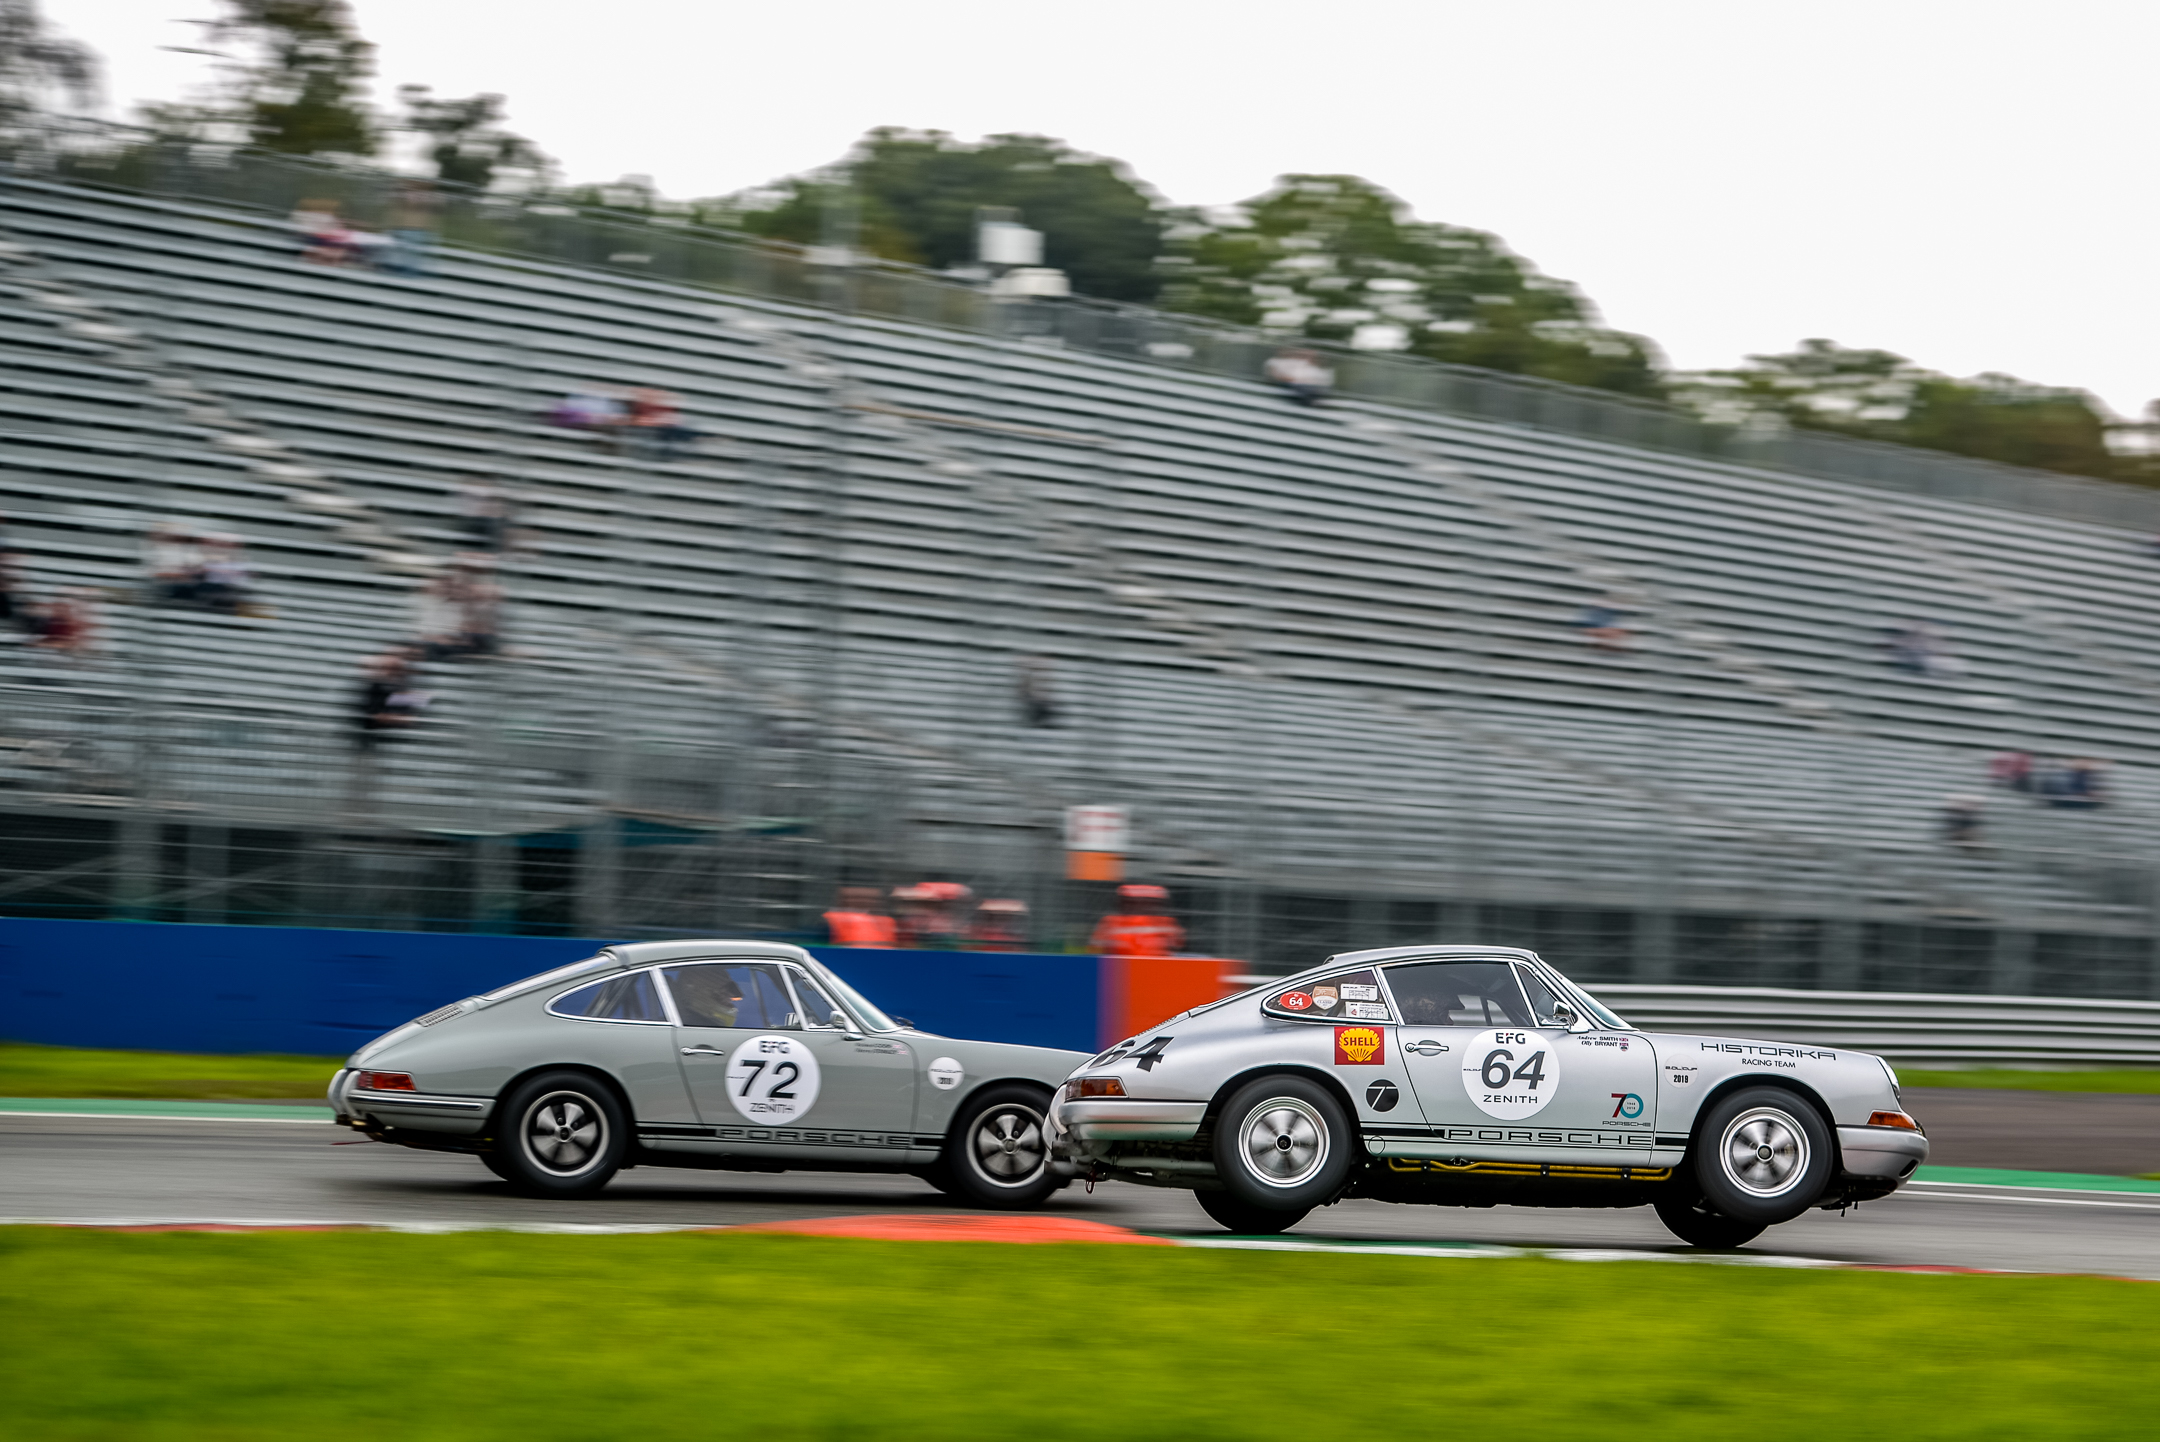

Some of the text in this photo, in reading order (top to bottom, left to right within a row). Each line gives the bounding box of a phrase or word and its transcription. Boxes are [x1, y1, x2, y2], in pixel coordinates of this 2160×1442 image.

[1289, 997, 1303, 1006] 64
[1343, 1037, 1375, 1046] SHELL
[1495, 1032, 1526, 1044] EFG
[1087, 1036, 1174, 1072] 64
[1700, 1042, 1837, 1061] HISTORIKA
[1481, 1049, 1546, 1090] 64
[1741, 1058, 1796, 1068] RACING TEAM
[739, 1059, 801, 1099] 72
[749, 1102, 796, 1114] ZENITH
[1483, 1094, 1538, 1104] ZENITH
[1611, 1093, 1644, 1118] 70
[720, 1128, 912, 1146] PORSCHE
[1449, 1128, 1652, 1146] PORSCHE
